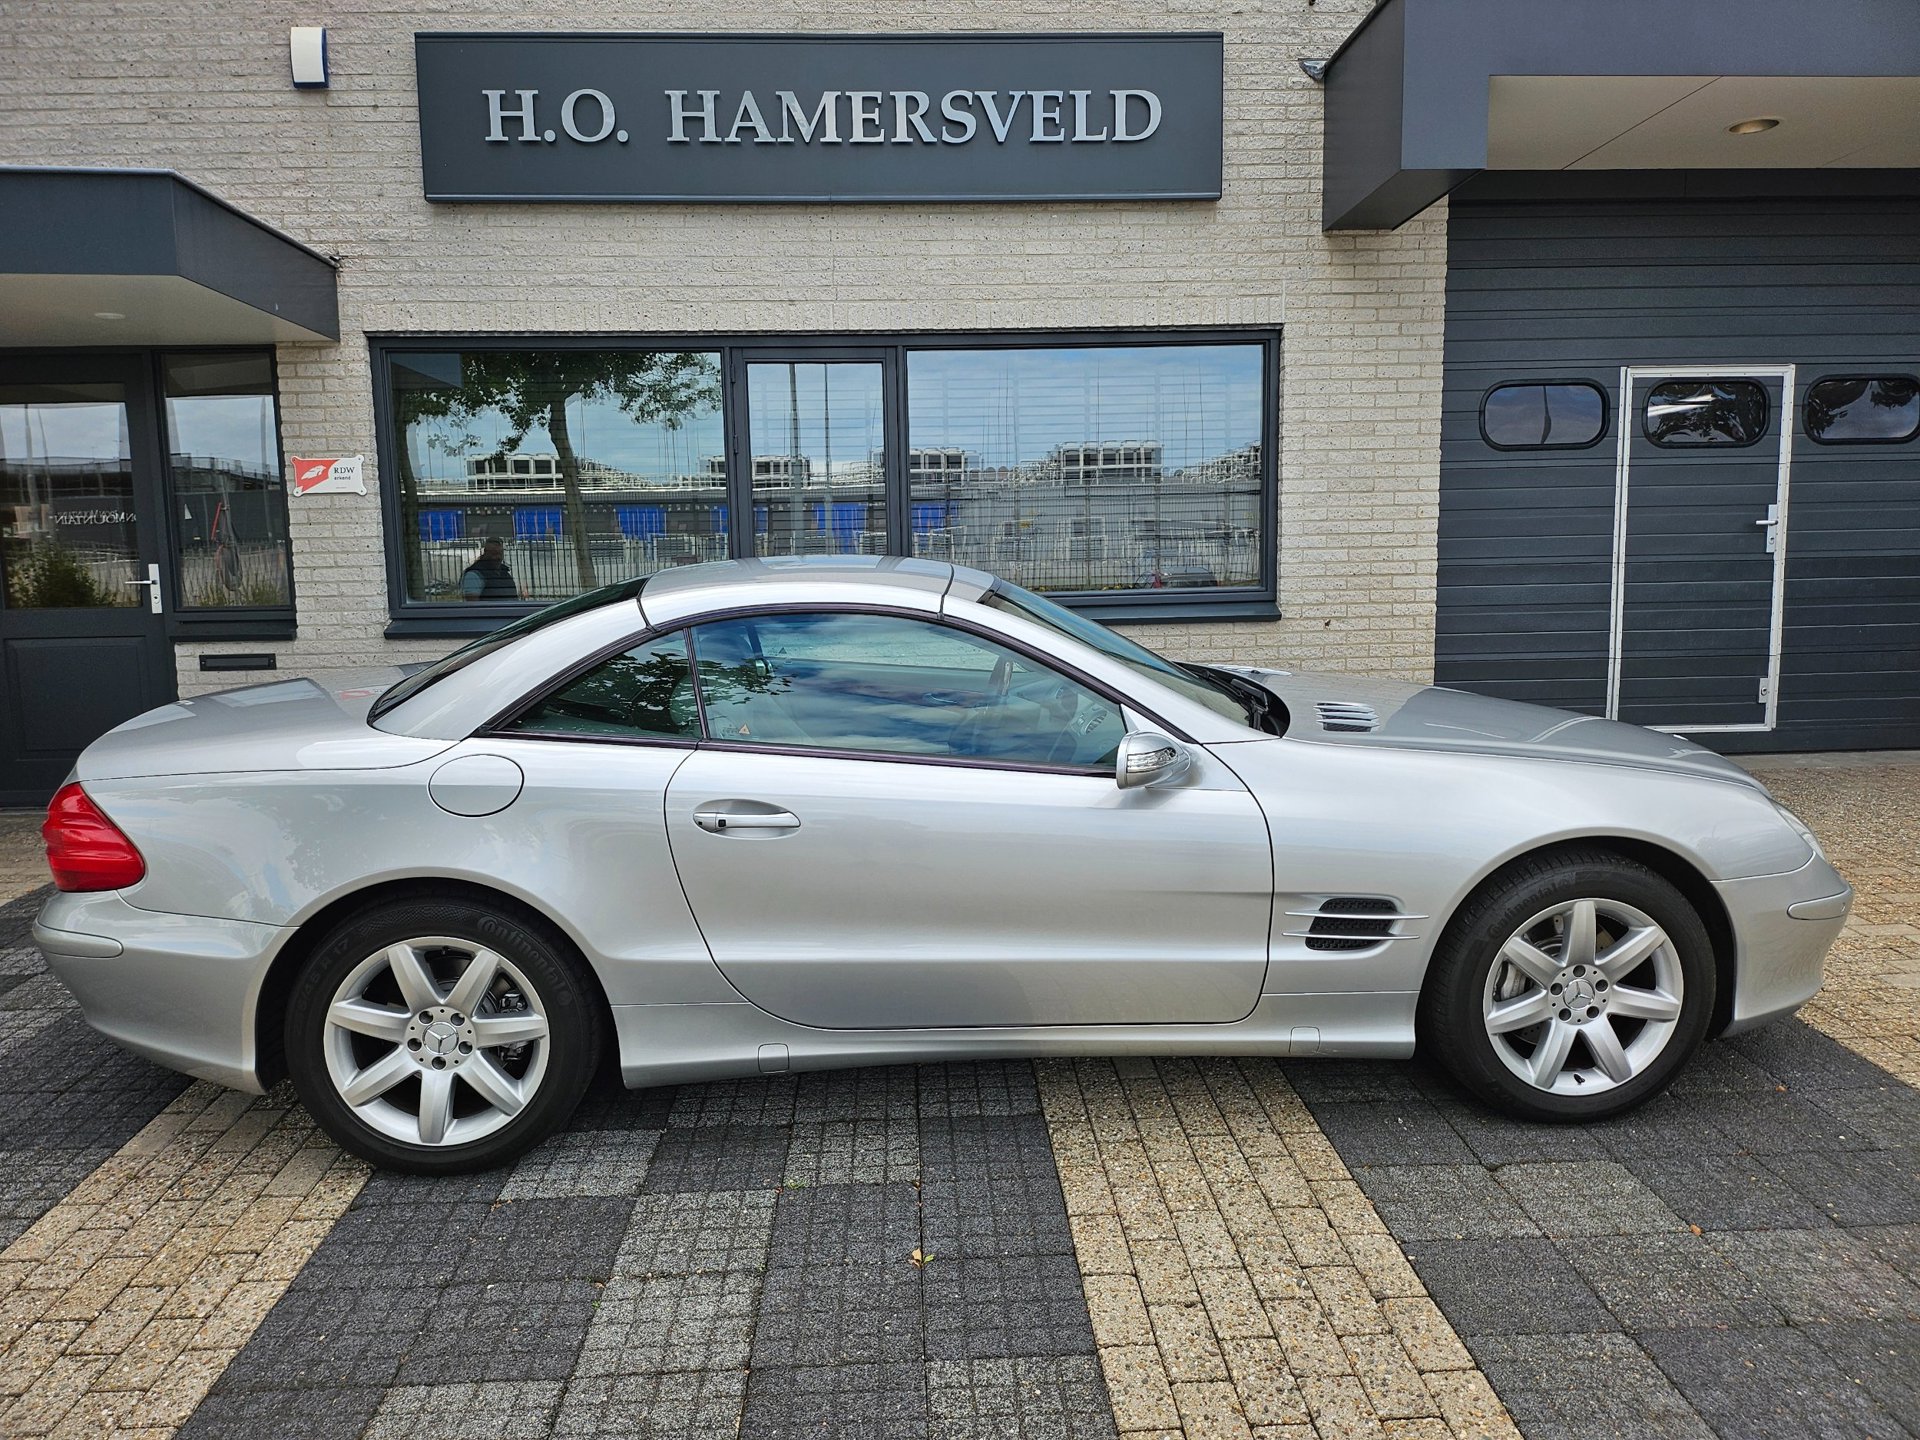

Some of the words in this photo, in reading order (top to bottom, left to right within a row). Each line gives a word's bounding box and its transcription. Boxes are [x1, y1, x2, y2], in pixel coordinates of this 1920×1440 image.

[482, 88, 629, 143] H.O.
[664, 89, 1162, 144] HAMERSVELD
[334, 466, 355, 474] RDW
[477, 916, 567, 990] Continental
